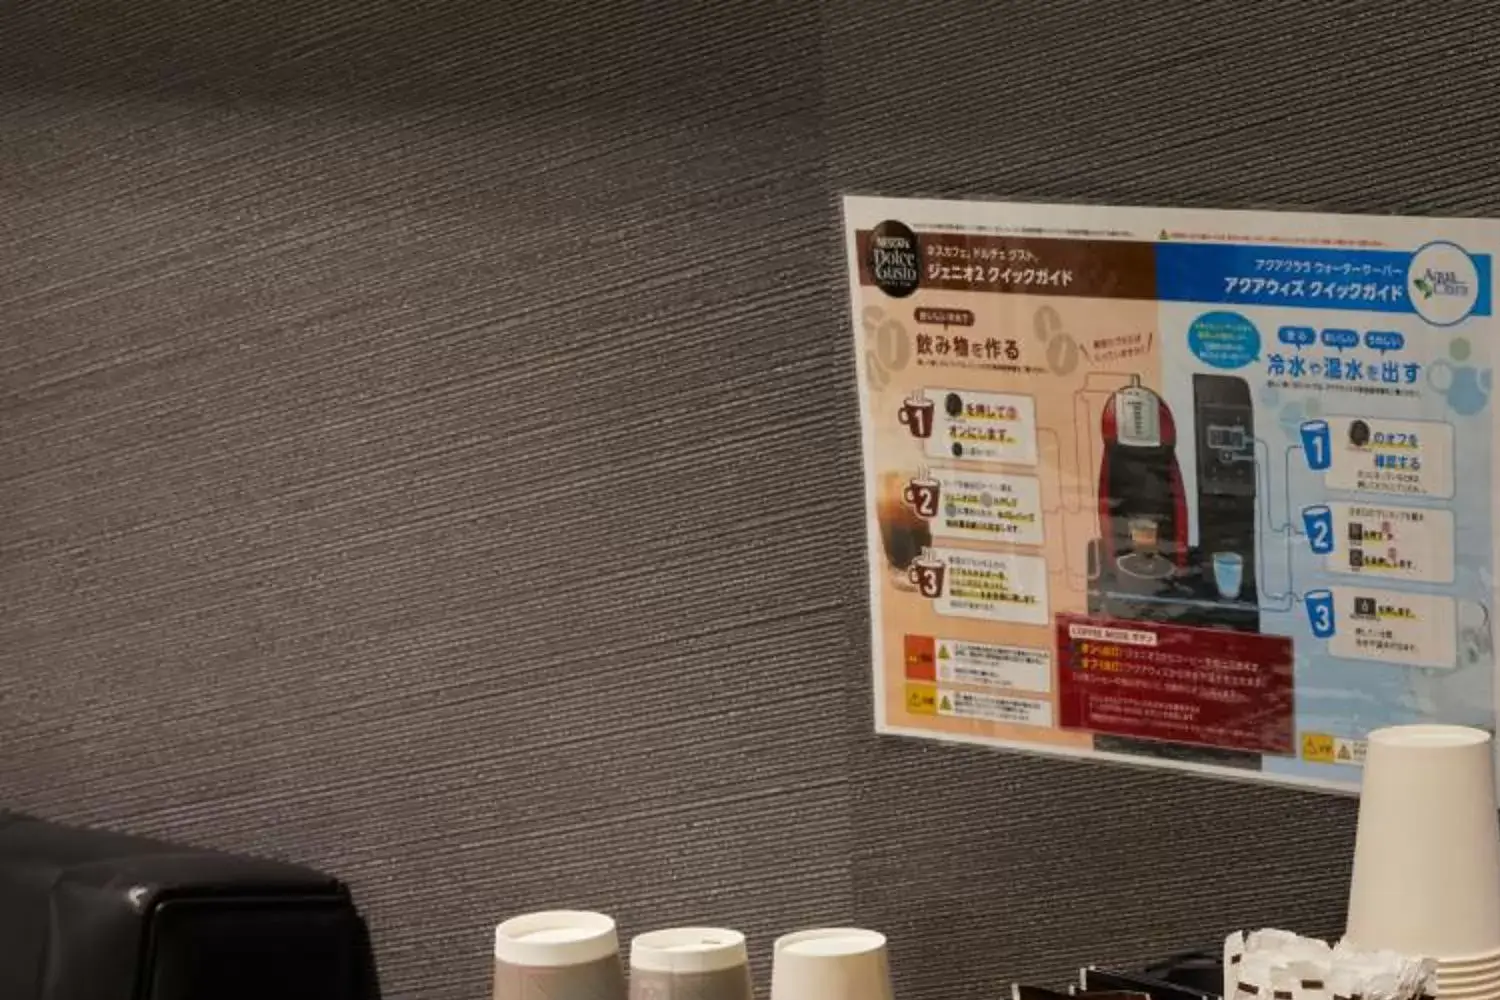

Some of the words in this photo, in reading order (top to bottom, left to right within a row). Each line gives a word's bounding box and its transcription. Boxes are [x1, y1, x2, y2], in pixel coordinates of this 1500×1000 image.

[988, 266, 1073, 287] クイックガイド
[1224, 277, 1305, 298] アクアウィズ
[1311, 280, 1403, 301] クイックガイド
[916, 333, 1019, 360] 飲み物を作る
[1267, 353, 1421, 384] 冷水や温水を出す
[914, 409, 925, 436] 1
[1312, 435, 1324, 464] 1
[919, 488, 933, 517] 2
[1313, 524, 1328, 548] 2
[924, 570, 937, 597] 3
[1316, 606, 1330, 629] 3
